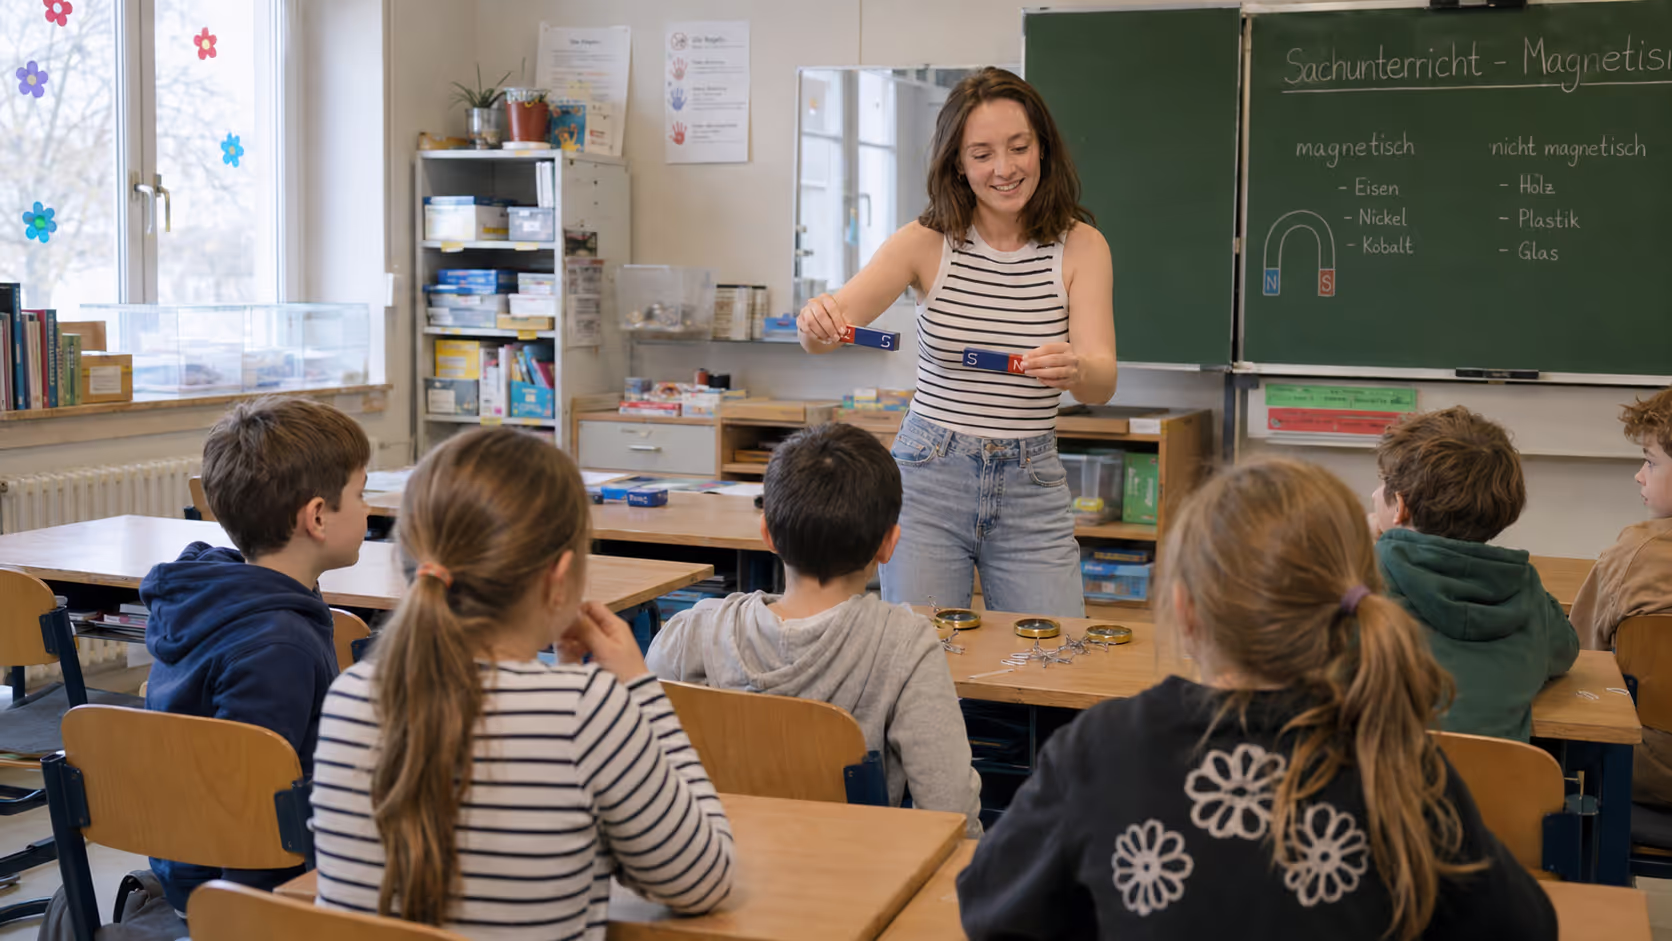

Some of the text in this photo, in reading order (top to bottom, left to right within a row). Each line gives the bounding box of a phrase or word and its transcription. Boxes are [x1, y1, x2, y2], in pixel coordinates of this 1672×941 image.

[1284, 42, 1483, 84] Sachunterricht
[1523, 34, 1672, 93] Magnetis
[1296, 131, 1415, 168] magnetisch
[1492, 133, 1647, 167] nicht magnetisch
[1355, 177, 1399, 196] Eisen
[1519, 174, 1556, 195] Holz
[1359, 207, 1408, 227] Nickel
[1518, 208, 1580, 229] Plastik
[1363, 235, 1414, 255] Kobalt
[1518, 241, 1559, 261] Glas
[1267, 274, 1277, 291] N
[1321, 274, 1332, 292] S
[967, 352, 1025, 372] S N
